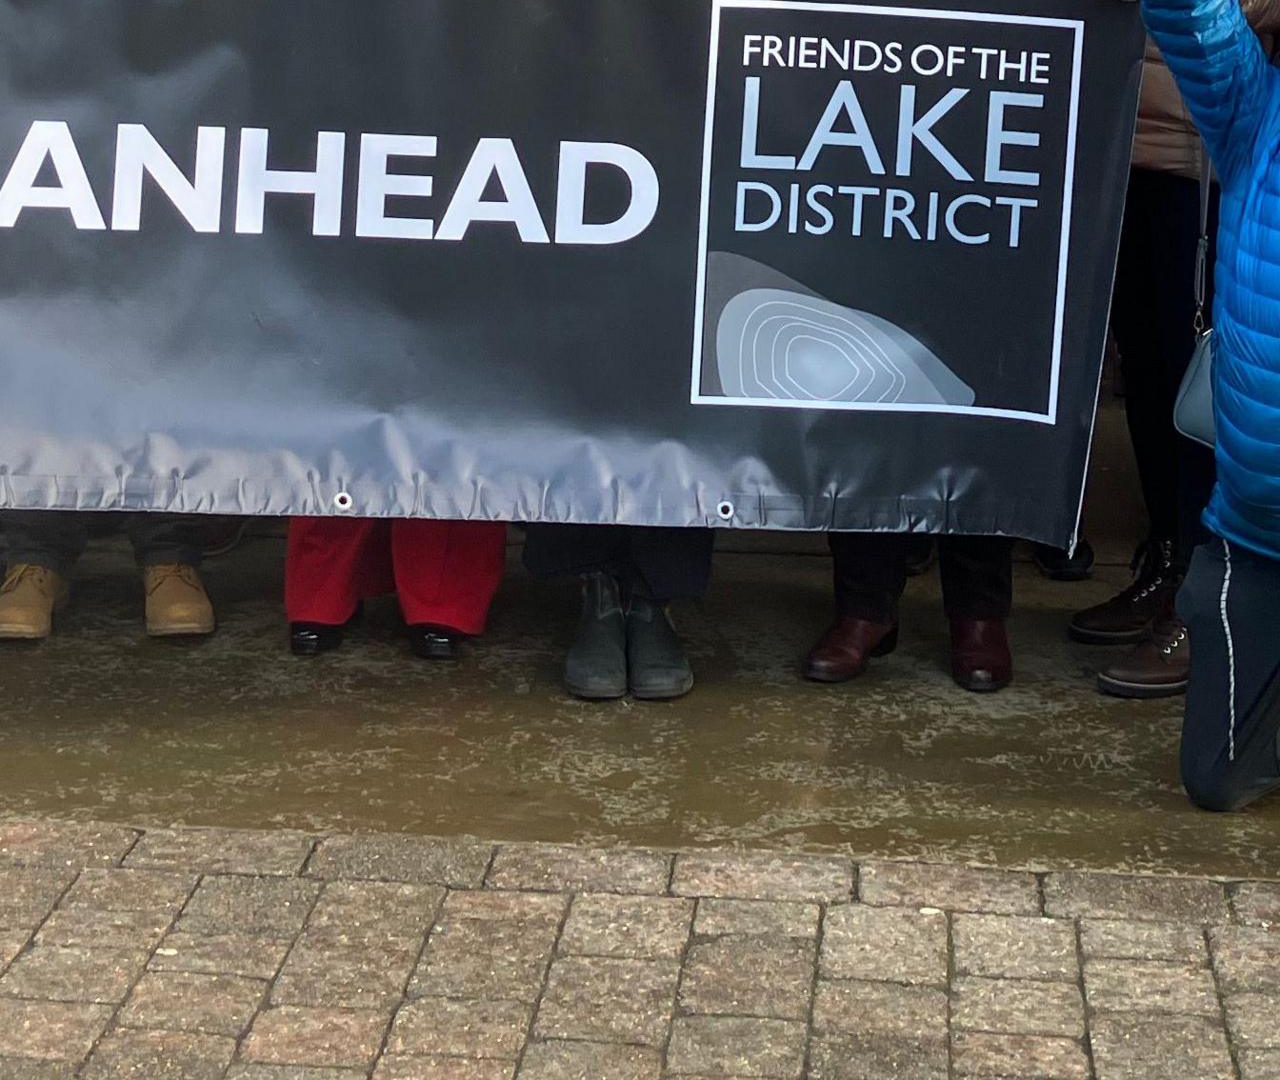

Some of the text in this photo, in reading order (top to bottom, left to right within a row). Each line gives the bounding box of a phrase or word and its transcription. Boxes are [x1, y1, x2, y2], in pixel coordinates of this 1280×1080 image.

[742, 35, 1051, 84] FRIENDS OF THE
[740, 76, 1045, 186] LAKE
[734, 181, 1039, 248] DISTRICT
